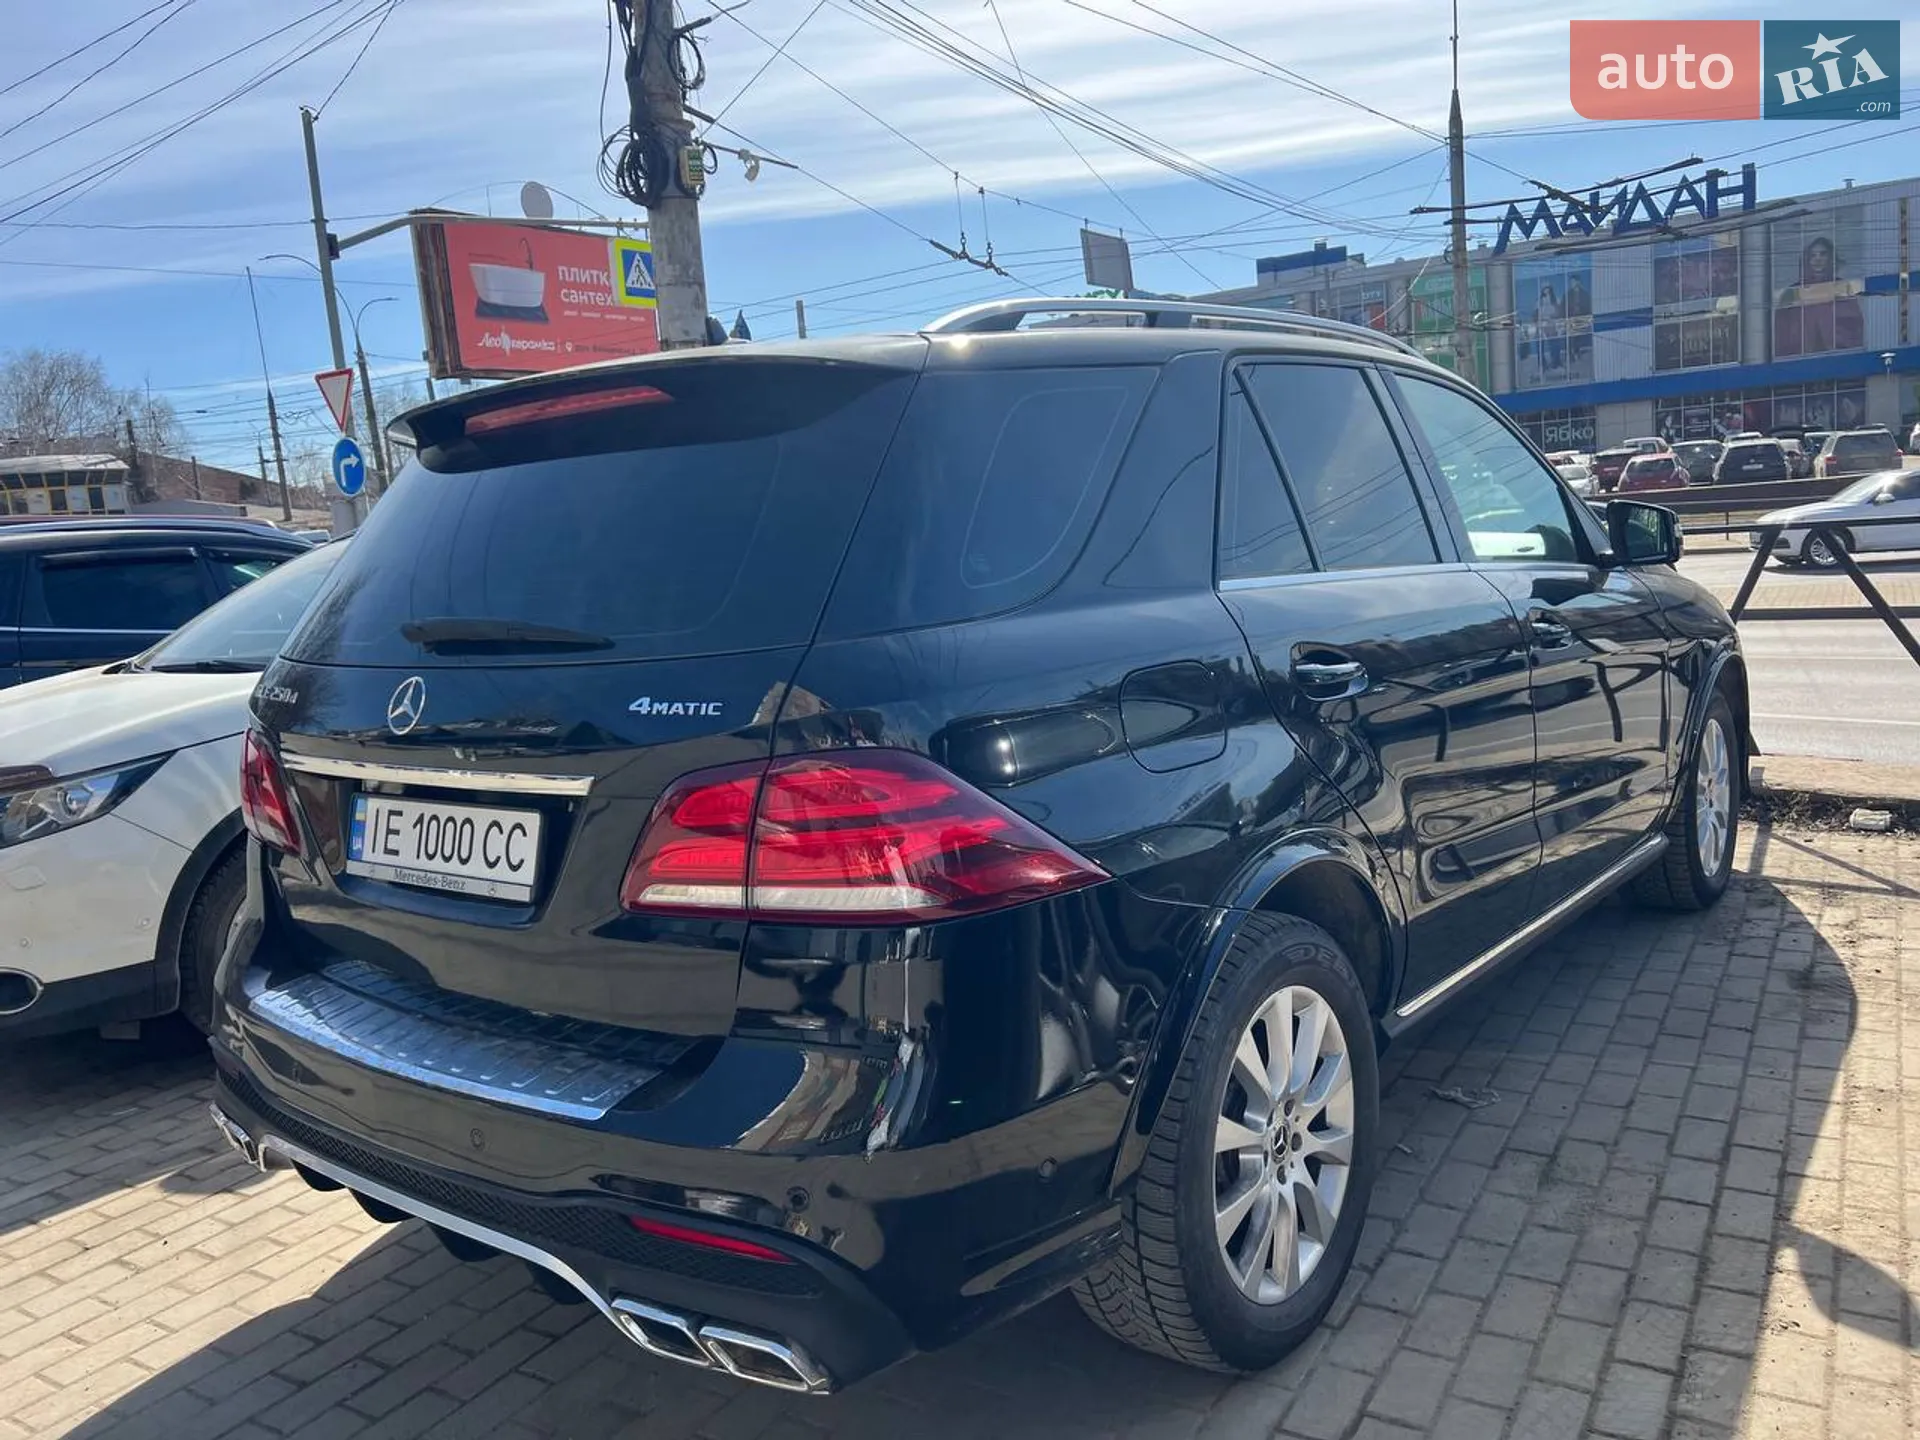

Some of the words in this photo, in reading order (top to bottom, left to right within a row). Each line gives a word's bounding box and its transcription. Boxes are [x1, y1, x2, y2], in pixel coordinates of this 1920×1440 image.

[629, 696, 723, 716] 4MATIC
[371, 807, 404, 856] IE
[412, 811, 475, 866] 1000
[482, 819, 528, 873] CC
